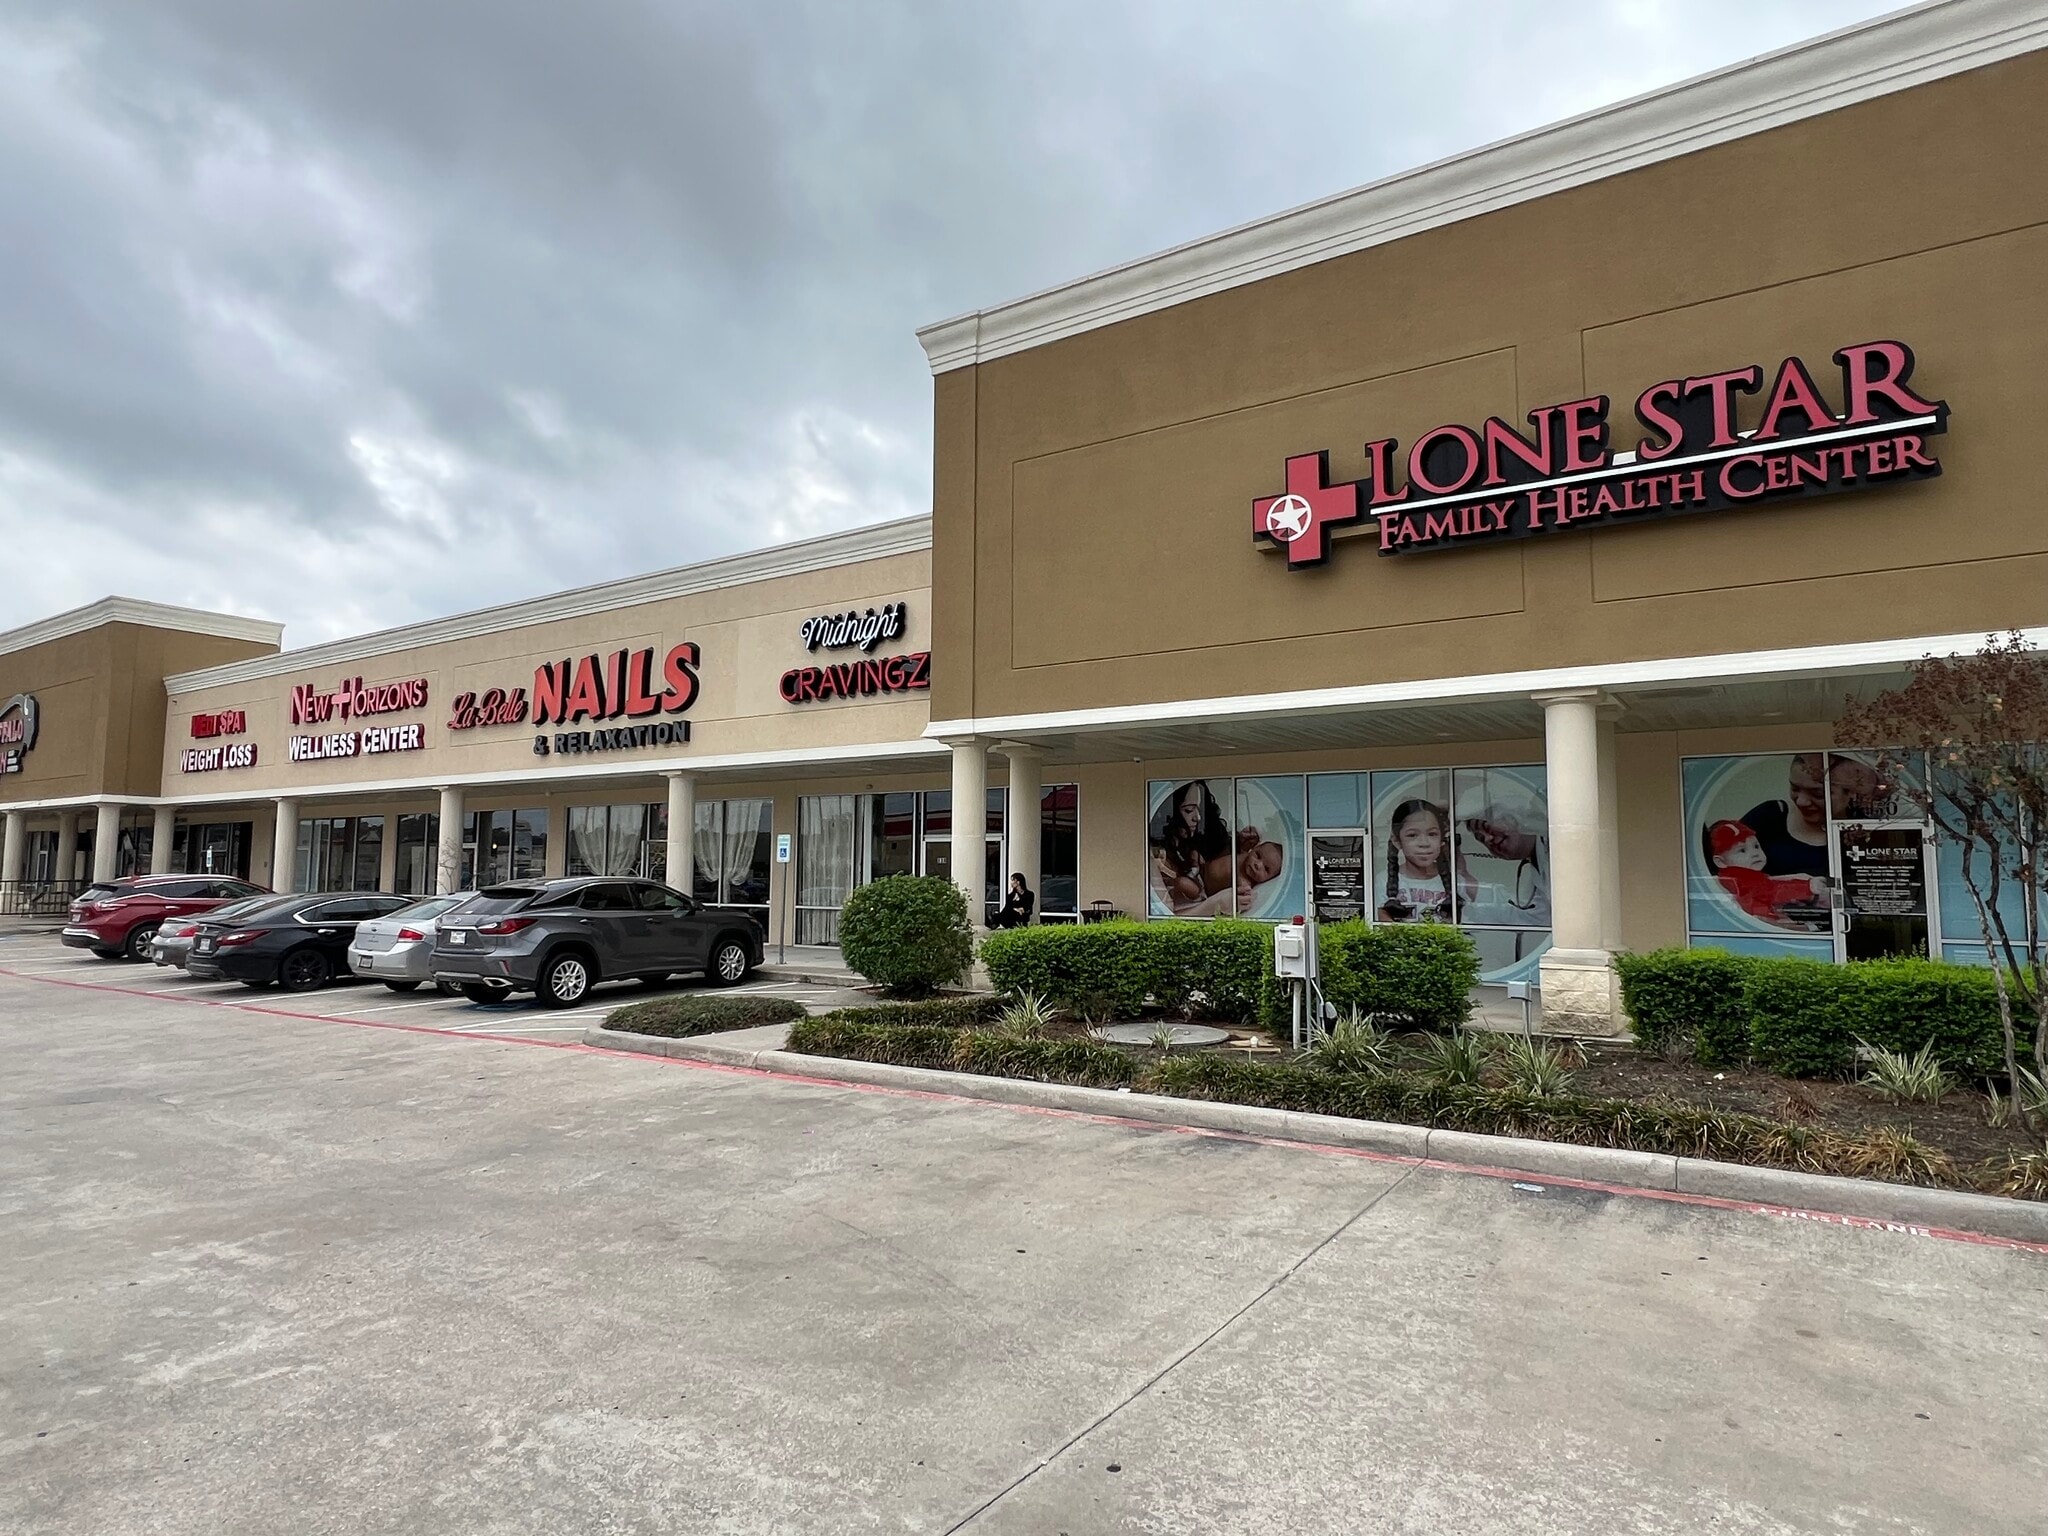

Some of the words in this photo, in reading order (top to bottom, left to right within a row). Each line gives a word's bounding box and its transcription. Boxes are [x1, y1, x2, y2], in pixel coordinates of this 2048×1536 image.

[1366, 396, 1607, 505] LONE
[1638, 342, 1940, 459] STAR
[1378, 498, 1515, 550] FAMILY
[1526, 471, 1706, 529] HEALTH
[1718, 435, 1938, 499] CENTER
[800, 603, 900, 651] Midnight
[289, 684, 330, 723] NEW
[331, 677, 428, 720] HORIZONS
[447, 691, 476, 730] La
[476, 687, 526, 727] Belle
[532, 643, 698, 725] NAILS
[779, 653, 930, 703] CRAVINGZ
[220, 710, 242, 732] SPA
[289, 732, 356, 761] WELLNESS
[361, 724, 420, 753] CENTER
[533, 735, 549, 754] &
[555, 720, 691, 752] RELAXATION
[180, 747, 220, 772] WEIGHT
[222, 743, 253, 768] LOSS
[1865, 848, 1891, 856] LONE
[1893, 848, 1917, 856] STAR
